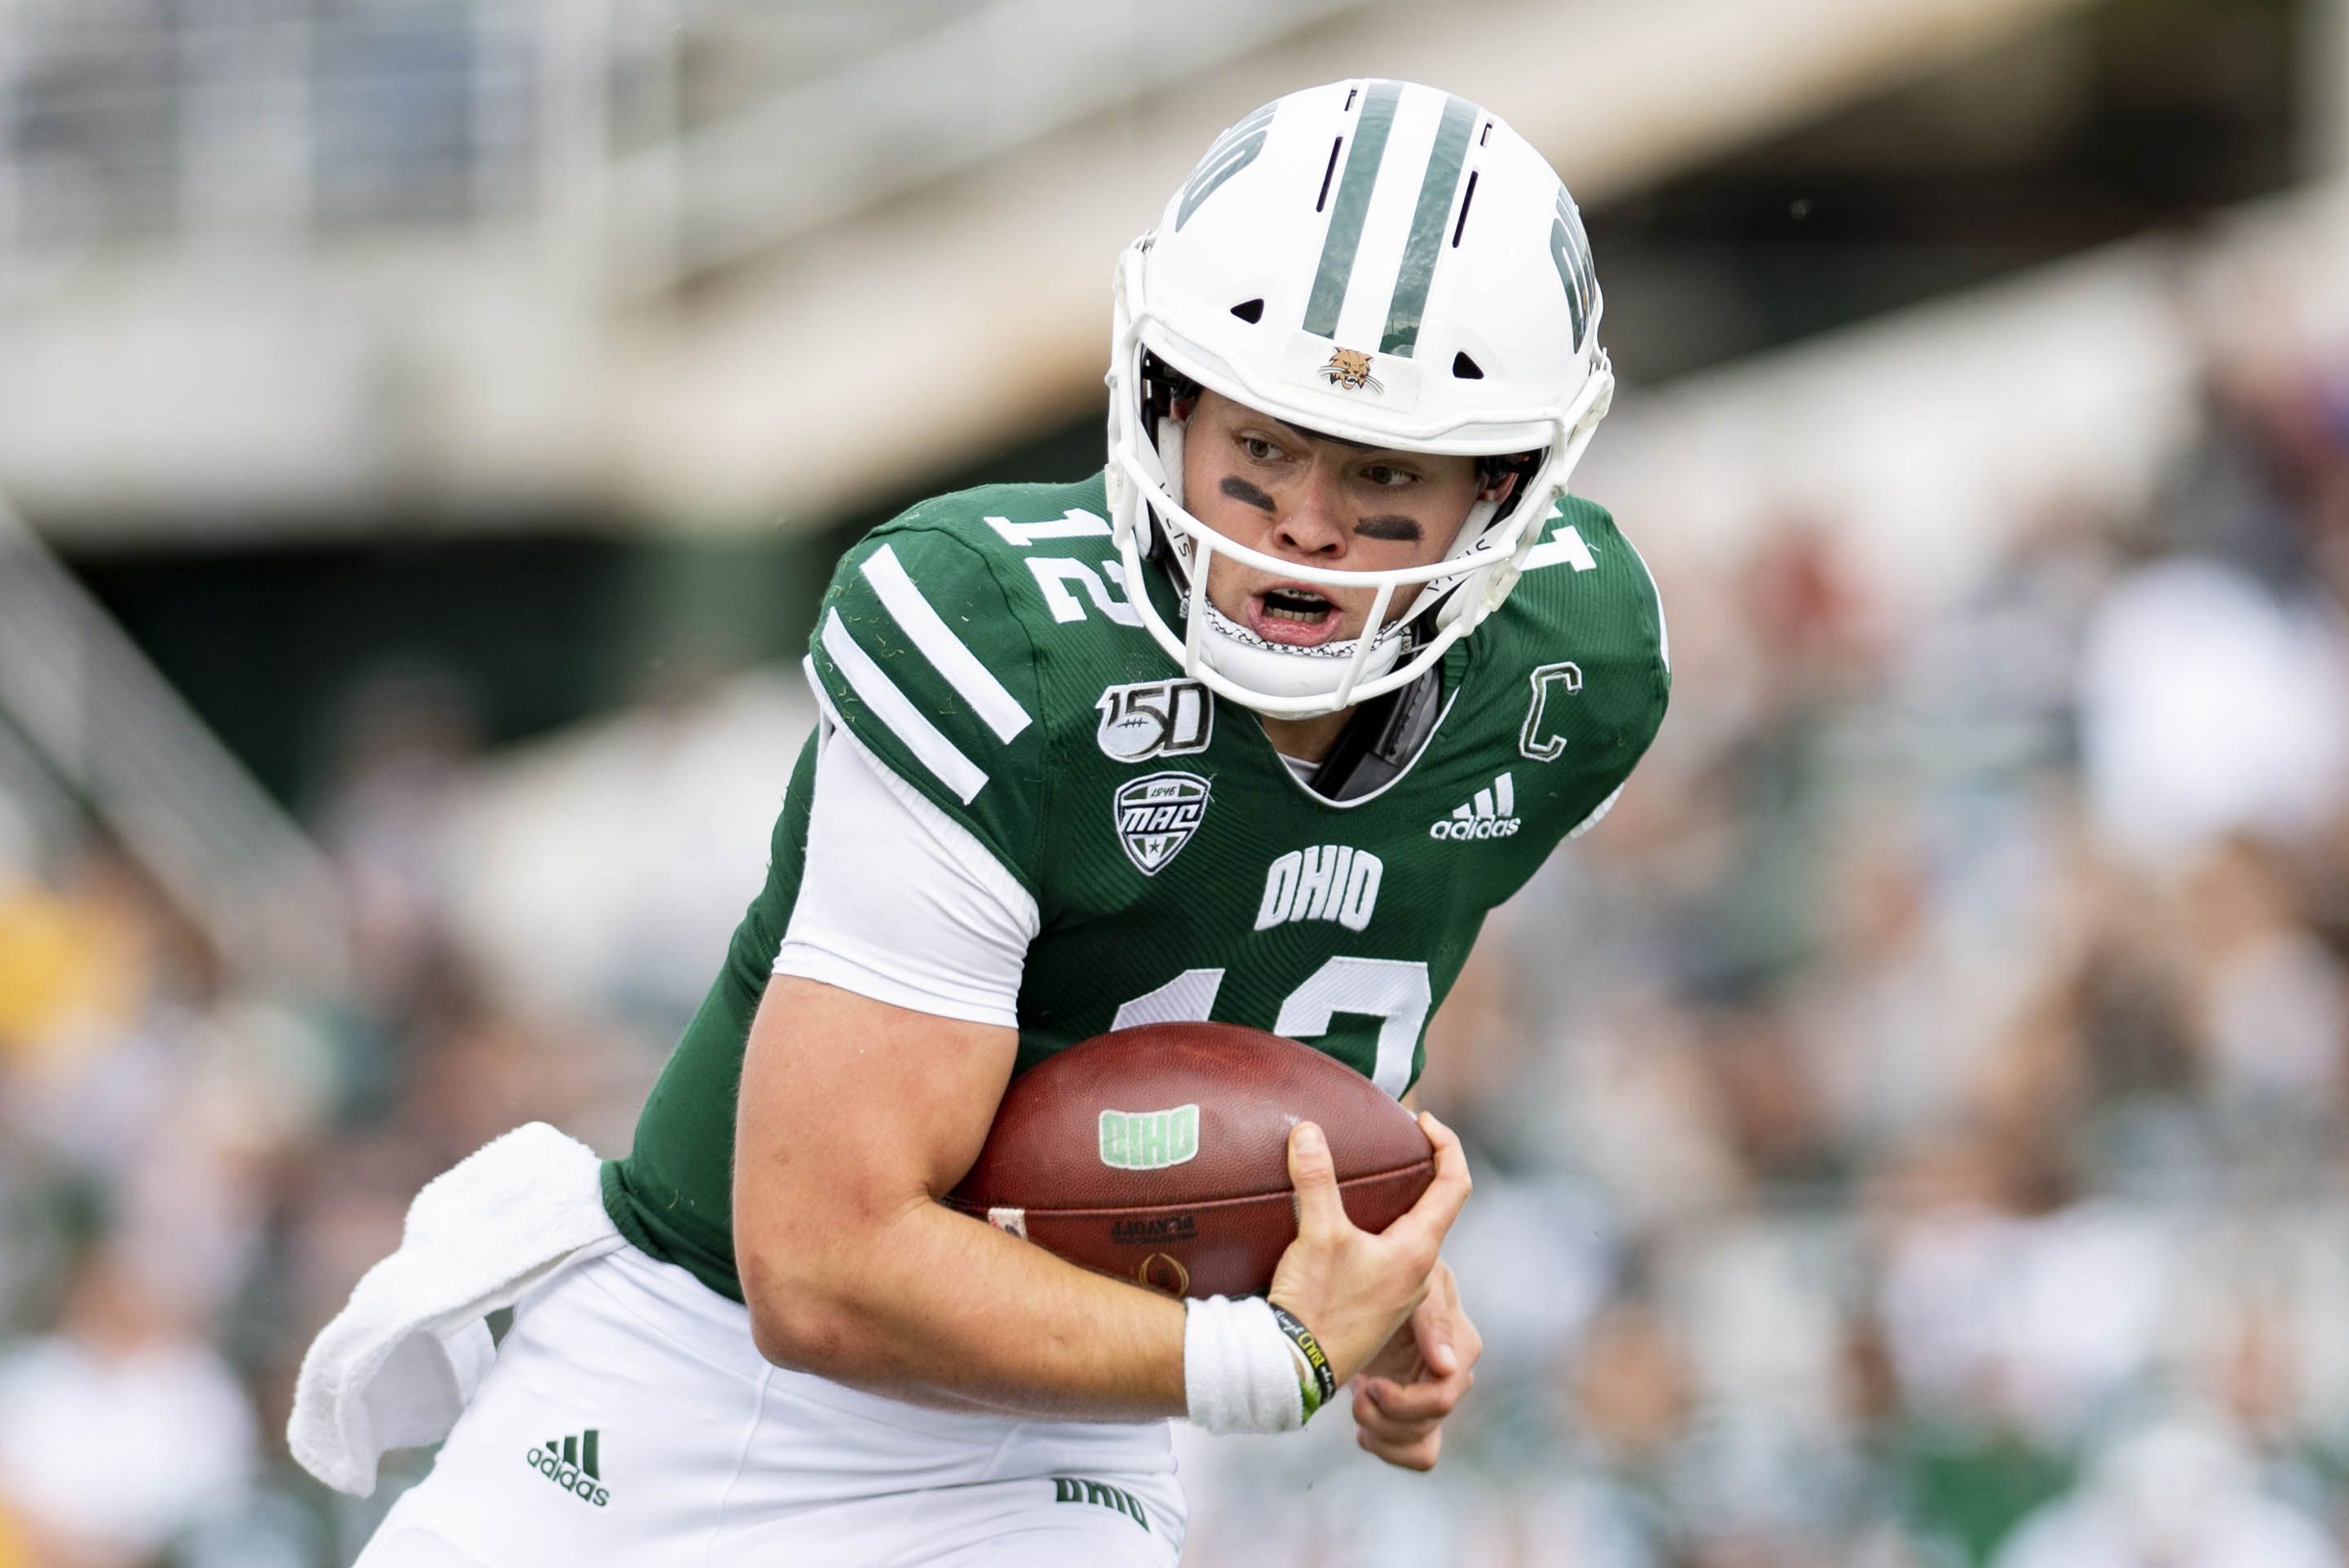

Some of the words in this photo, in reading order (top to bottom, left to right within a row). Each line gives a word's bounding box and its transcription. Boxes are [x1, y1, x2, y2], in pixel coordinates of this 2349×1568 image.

[983, 507, 1145, 628] 12
[1520, 506, 1597, 572] 1
[1103, 681, 1213, 759] 150
[1519, 661, 1582, 762] C
[1120, 804, 1200, 833] MAC
[1151, 786, 1177, 797] 1946
[1430, 815, 1521, 840] adidas
[1254, 845, 1384, 932] OHIO
[527, 1447, 609, 1507] adidas
